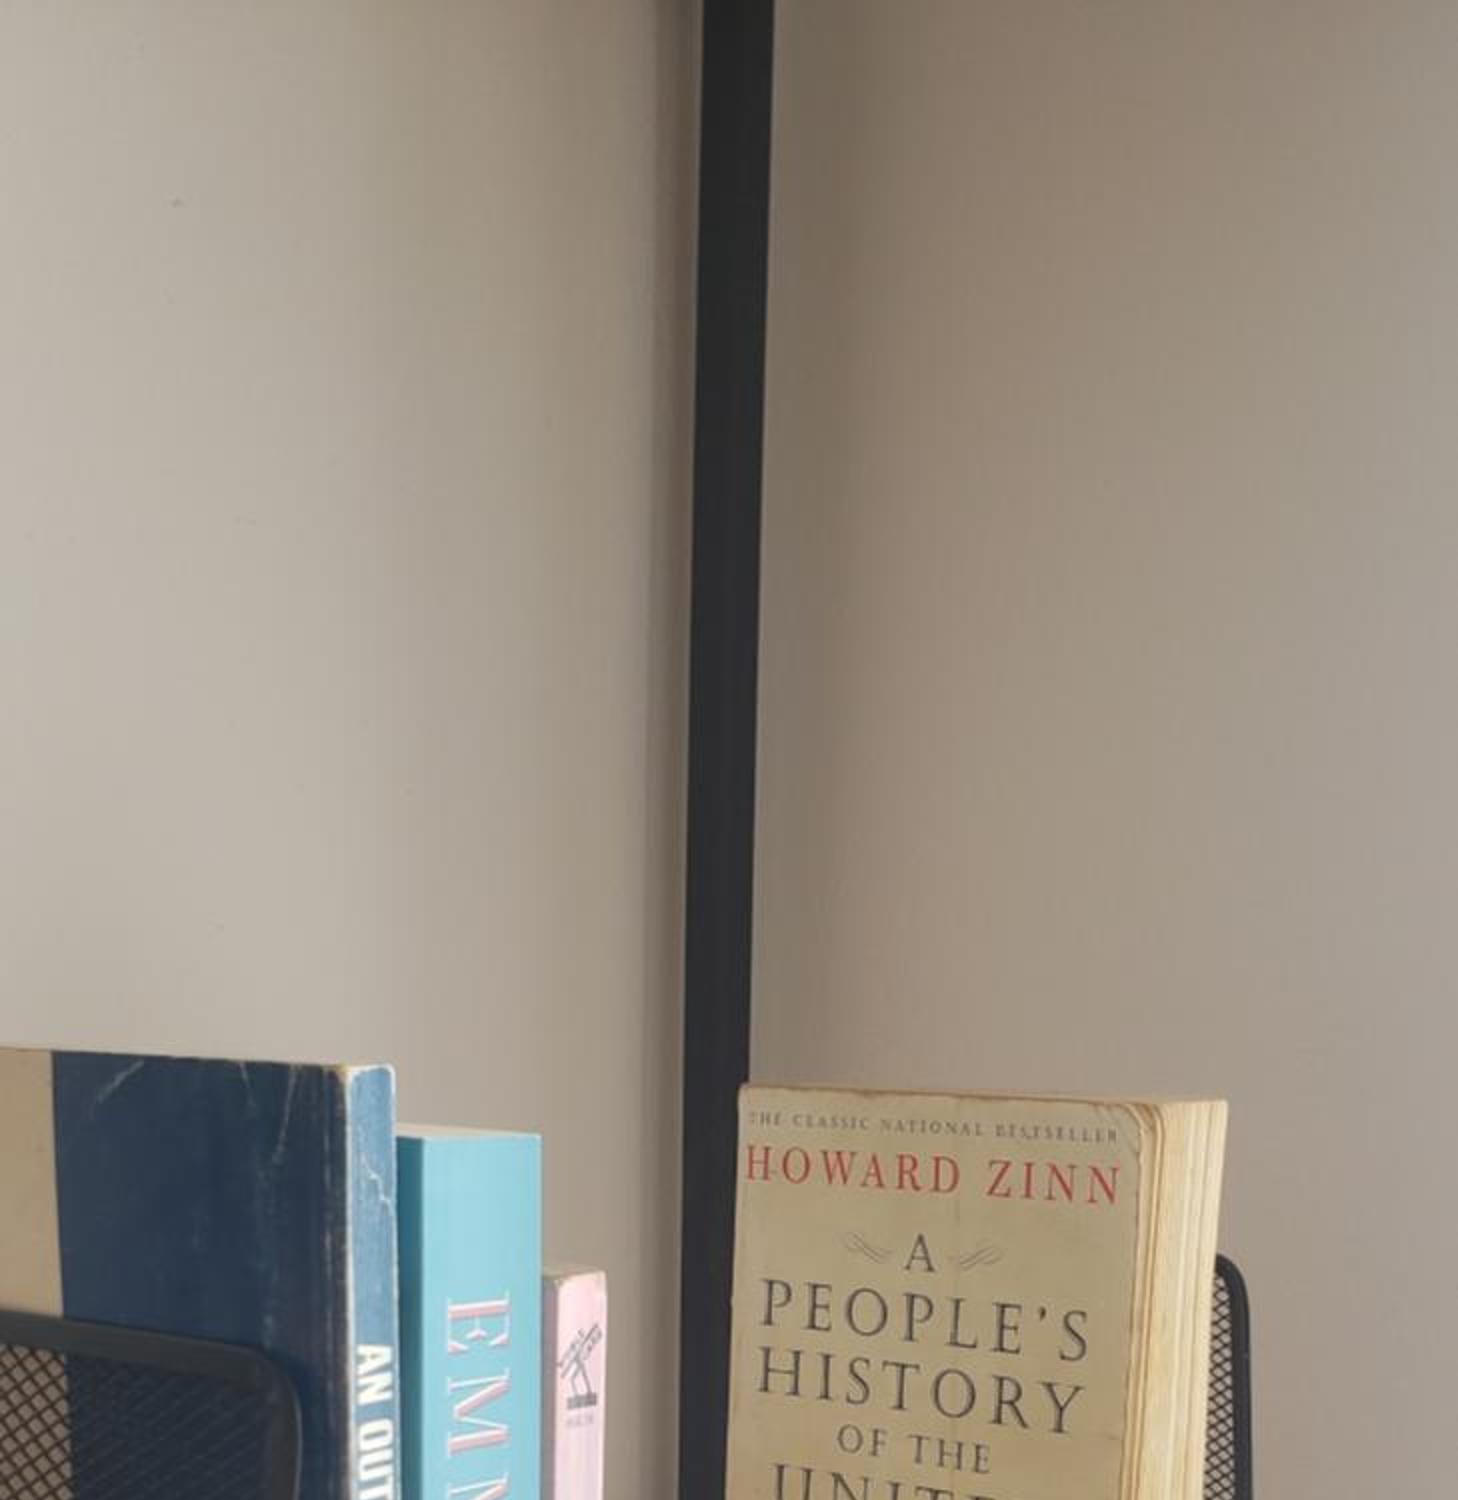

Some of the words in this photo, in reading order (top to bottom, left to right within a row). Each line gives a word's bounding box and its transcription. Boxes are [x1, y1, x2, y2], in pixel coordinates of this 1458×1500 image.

[749, 1111, 783, 1127] THE
[792, 1113, 869, 1131] CLASSIC
[881, 1118, 983, 1137] NATIONAL
[995, 1125, 1118, 1143] BESTSELLER
[746, 1145, 960, 1192] HOWARD
[987, 1160, 1121, 1204] ZINN
[903, 1233, 936, 1274] A
[761, 1278, 1089, 1362] PEOPLE'S
[357, 1344, 393, 1404] AN
[756, 1345, 1086, 1435] HISTORY
[836, 1424, 887, 1458] OF
[908, 1434, 991, 1475] THE
